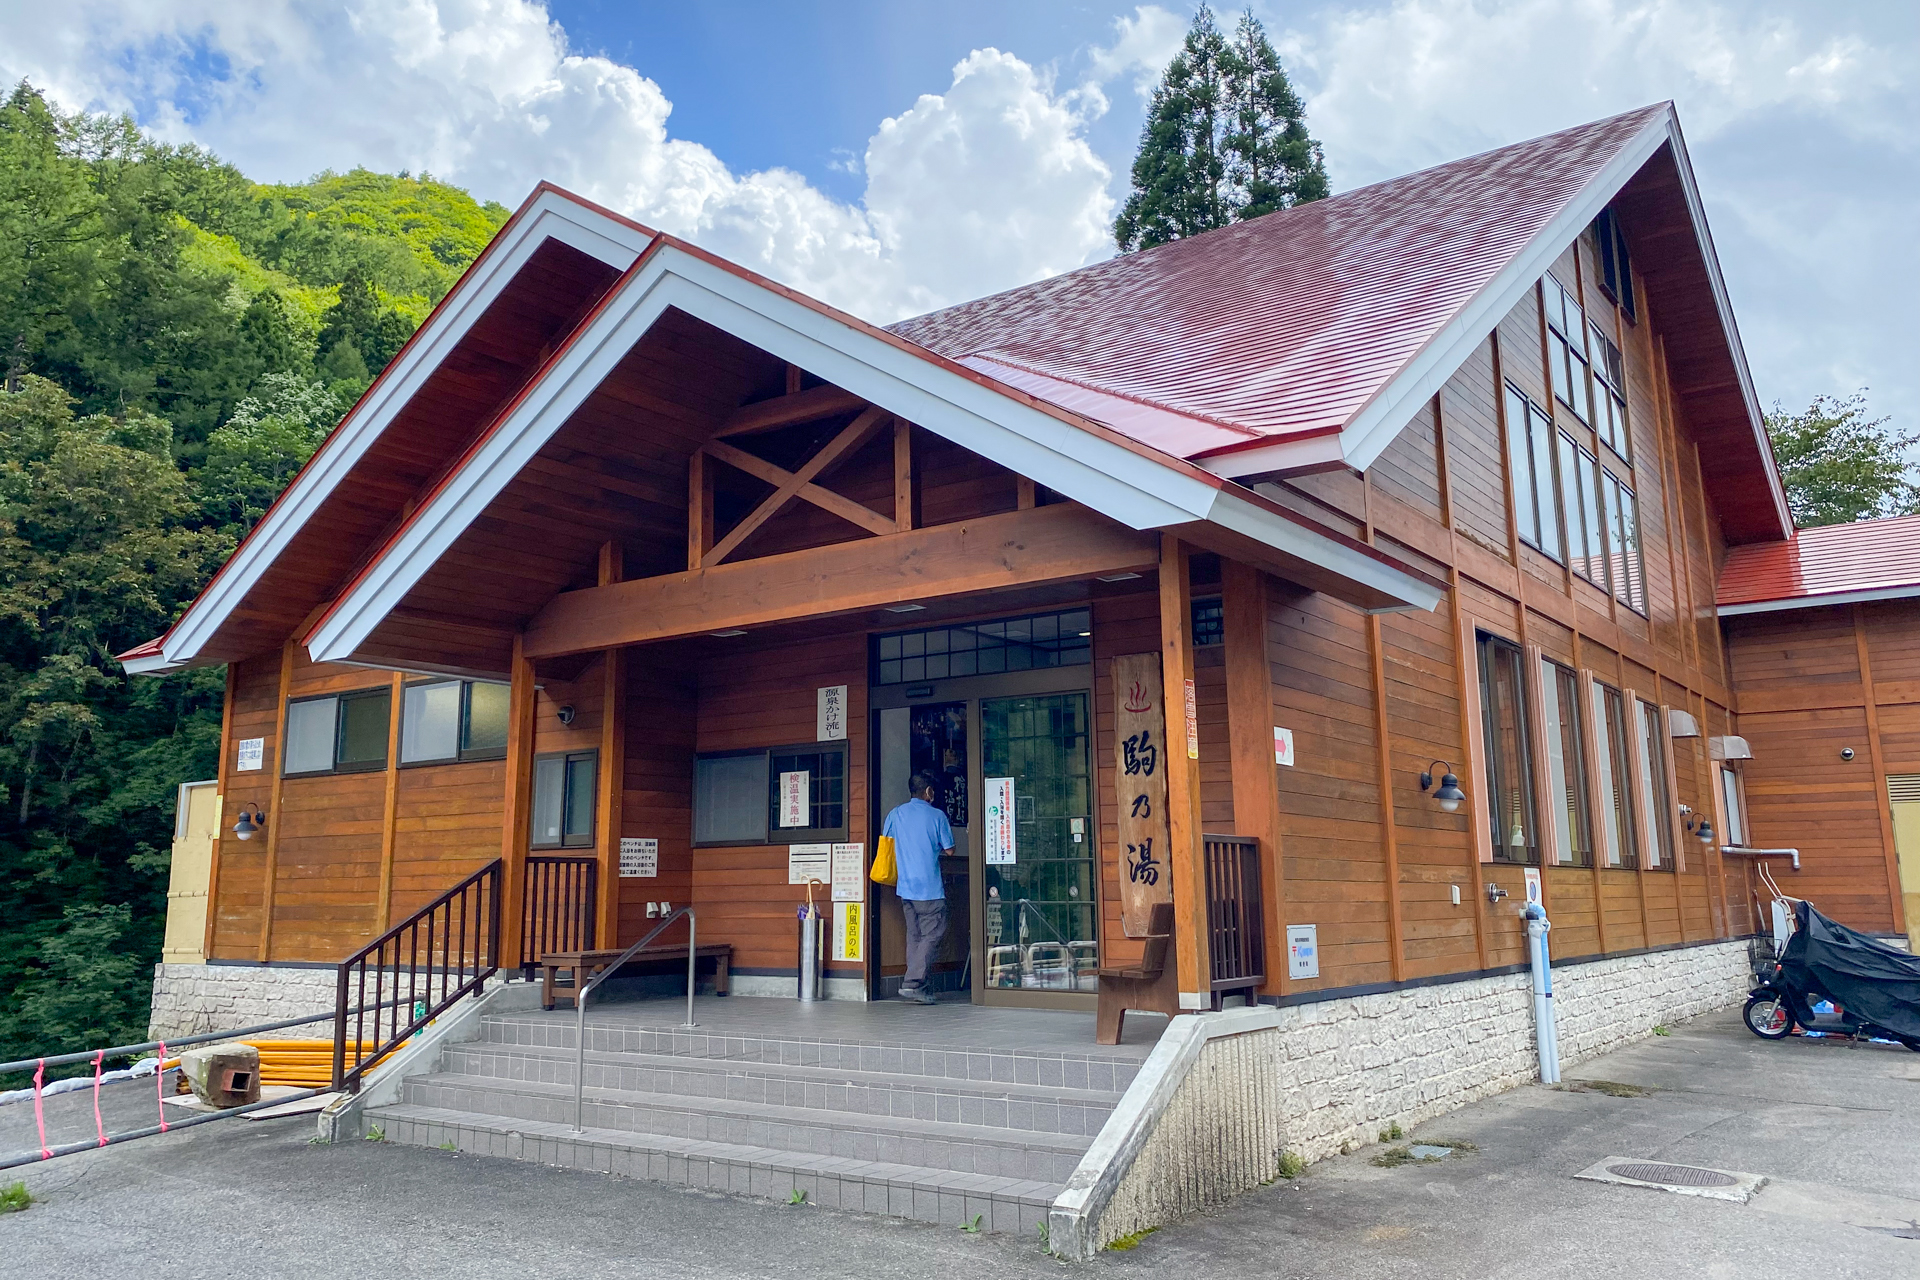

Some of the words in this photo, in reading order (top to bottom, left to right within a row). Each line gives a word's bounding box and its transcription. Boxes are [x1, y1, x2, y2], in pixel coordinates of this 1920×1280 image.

[825, 687, 840, 738] 源泉かけ流し
[790, 773, 800, 825] 検温実施中
[1122, 730, 1161, 886] 駒乃湯
[849, 903, 858, 958] 内風呂のみ
